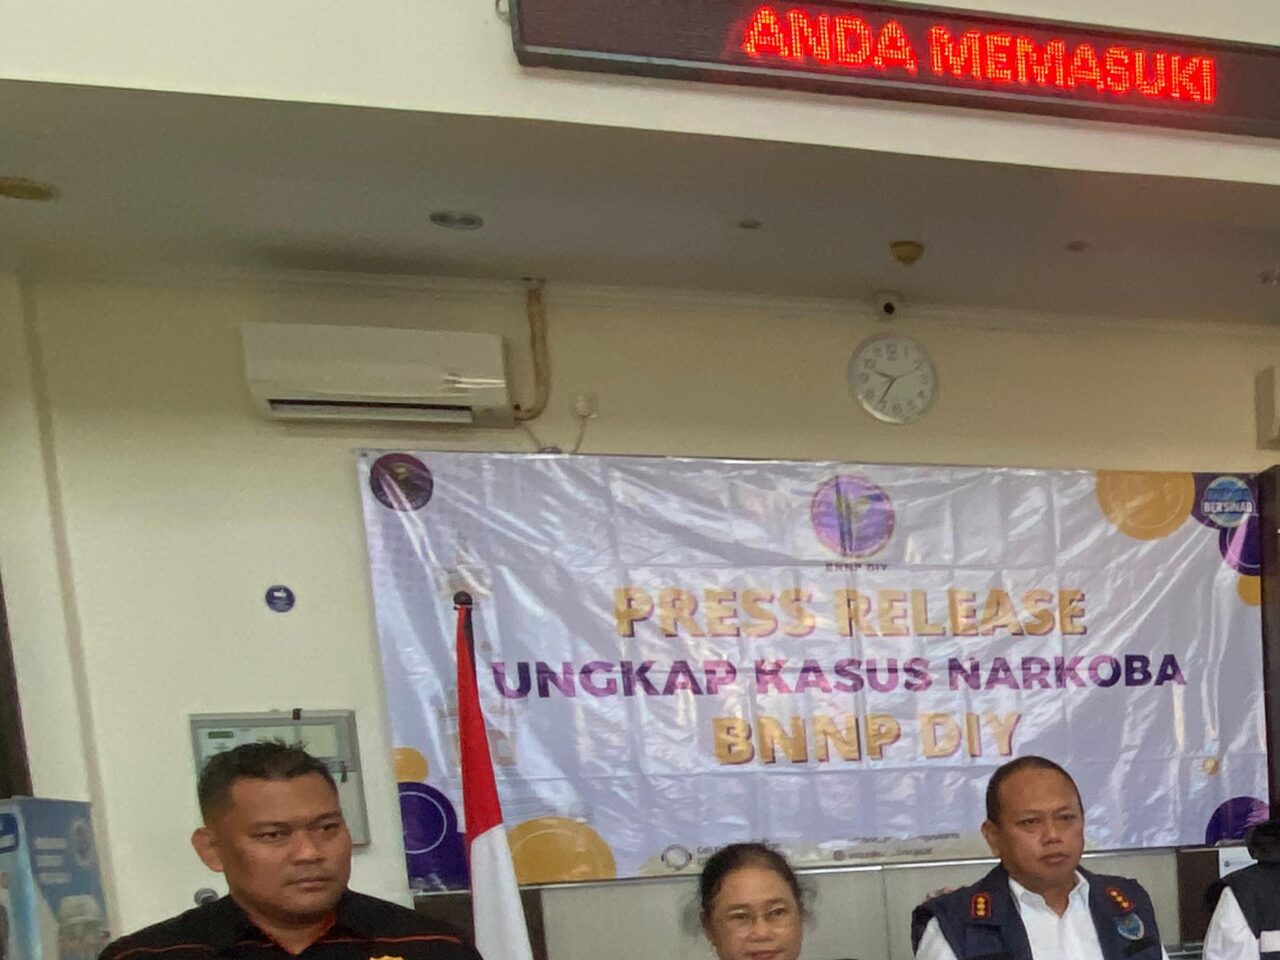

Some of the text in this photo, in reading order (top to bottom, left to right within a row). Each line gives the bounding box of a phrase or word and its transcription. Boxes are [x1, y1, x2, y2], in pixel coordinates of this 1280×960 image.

[745, 5, 1216, 103] ANDA MEMASUKI
[612, 586, 1088, 638] PRESS RELEASE
[491, 654, 1187, 699] UNGKAP KASUS NARKOBA
[712, 710, 1022, 765] BNNP DIY
